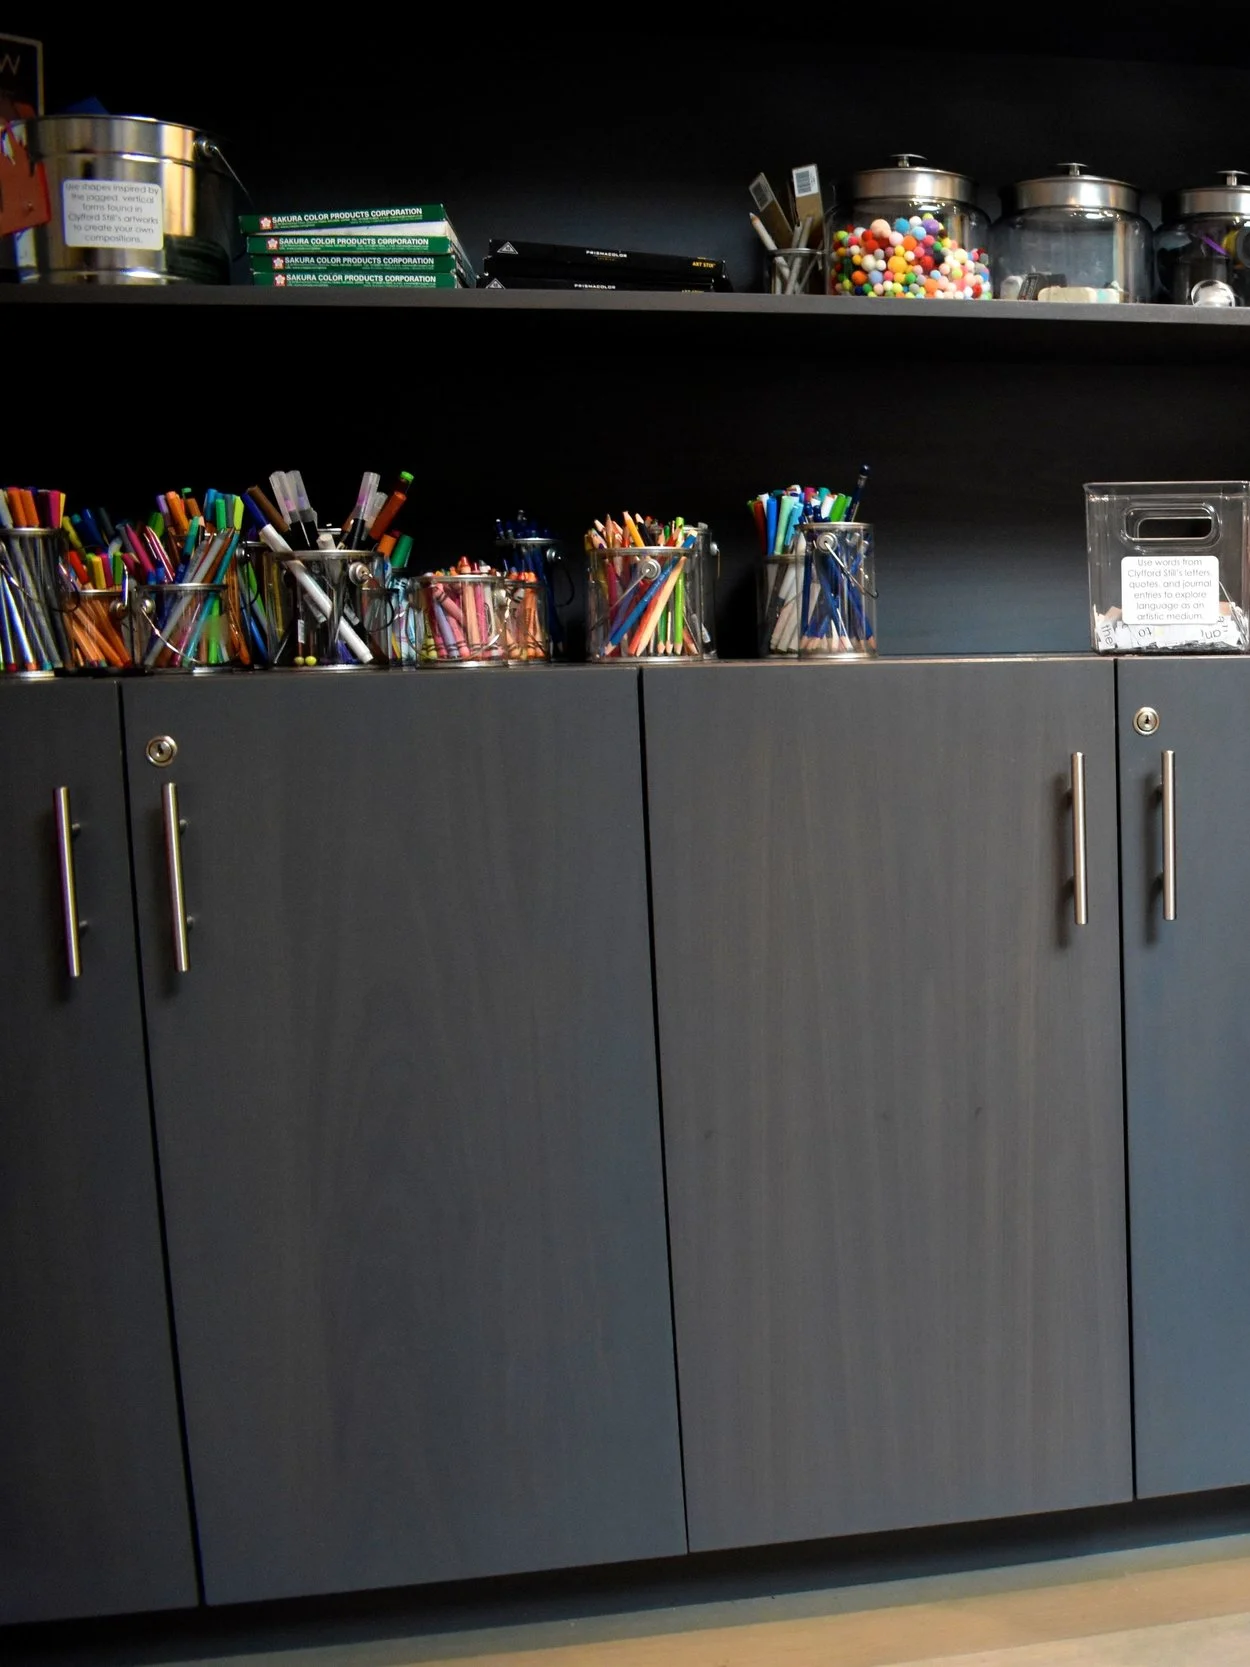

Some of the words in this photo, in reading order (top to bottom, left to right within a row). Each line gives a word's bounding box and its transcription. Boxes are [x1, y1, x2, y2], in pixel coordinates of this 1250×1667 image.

[113, 185, 146, 194] inspired
[148, 186, 159, 195] by
[122, 196, 154, 204] vertical
[107, 204, 133, 212] found
[123, 216, 159, 224] artworks
[272, 215, 302, 224] SAKURA
[304, 213, 329, 221] COLOR
[330, 211, 369, 220] PRODUCTS
[370, 208, 422, 217] CORPORATION
[114, 226, 133, 234] your
[585, 250, 628, 258] PRISMACOLOR
[344, 274, 383, 282] PRODUCTS
[385, 275, 436, 283] CORPORATION
[1137, 559, 1153, 567] Use
[1155, 559, 1180, 567] words
[1182, 558, 1202, 566] from
[1127, 569, 1161, 578] Clyfford
[1163, 569, 1183, 577] Still's
[1163, 580, 1181, 588] and
[1182, 580, 1212, 589] journal
[1133, 591, 1162, 599] entries
[1164, 591, 1173, 599] to
[1175, 591, 1207, 600] explore
[1136, 602, 1178, 611] language
[1136, 613, 1164, 621] artistic
[1100, 624, 1113, 645] the
